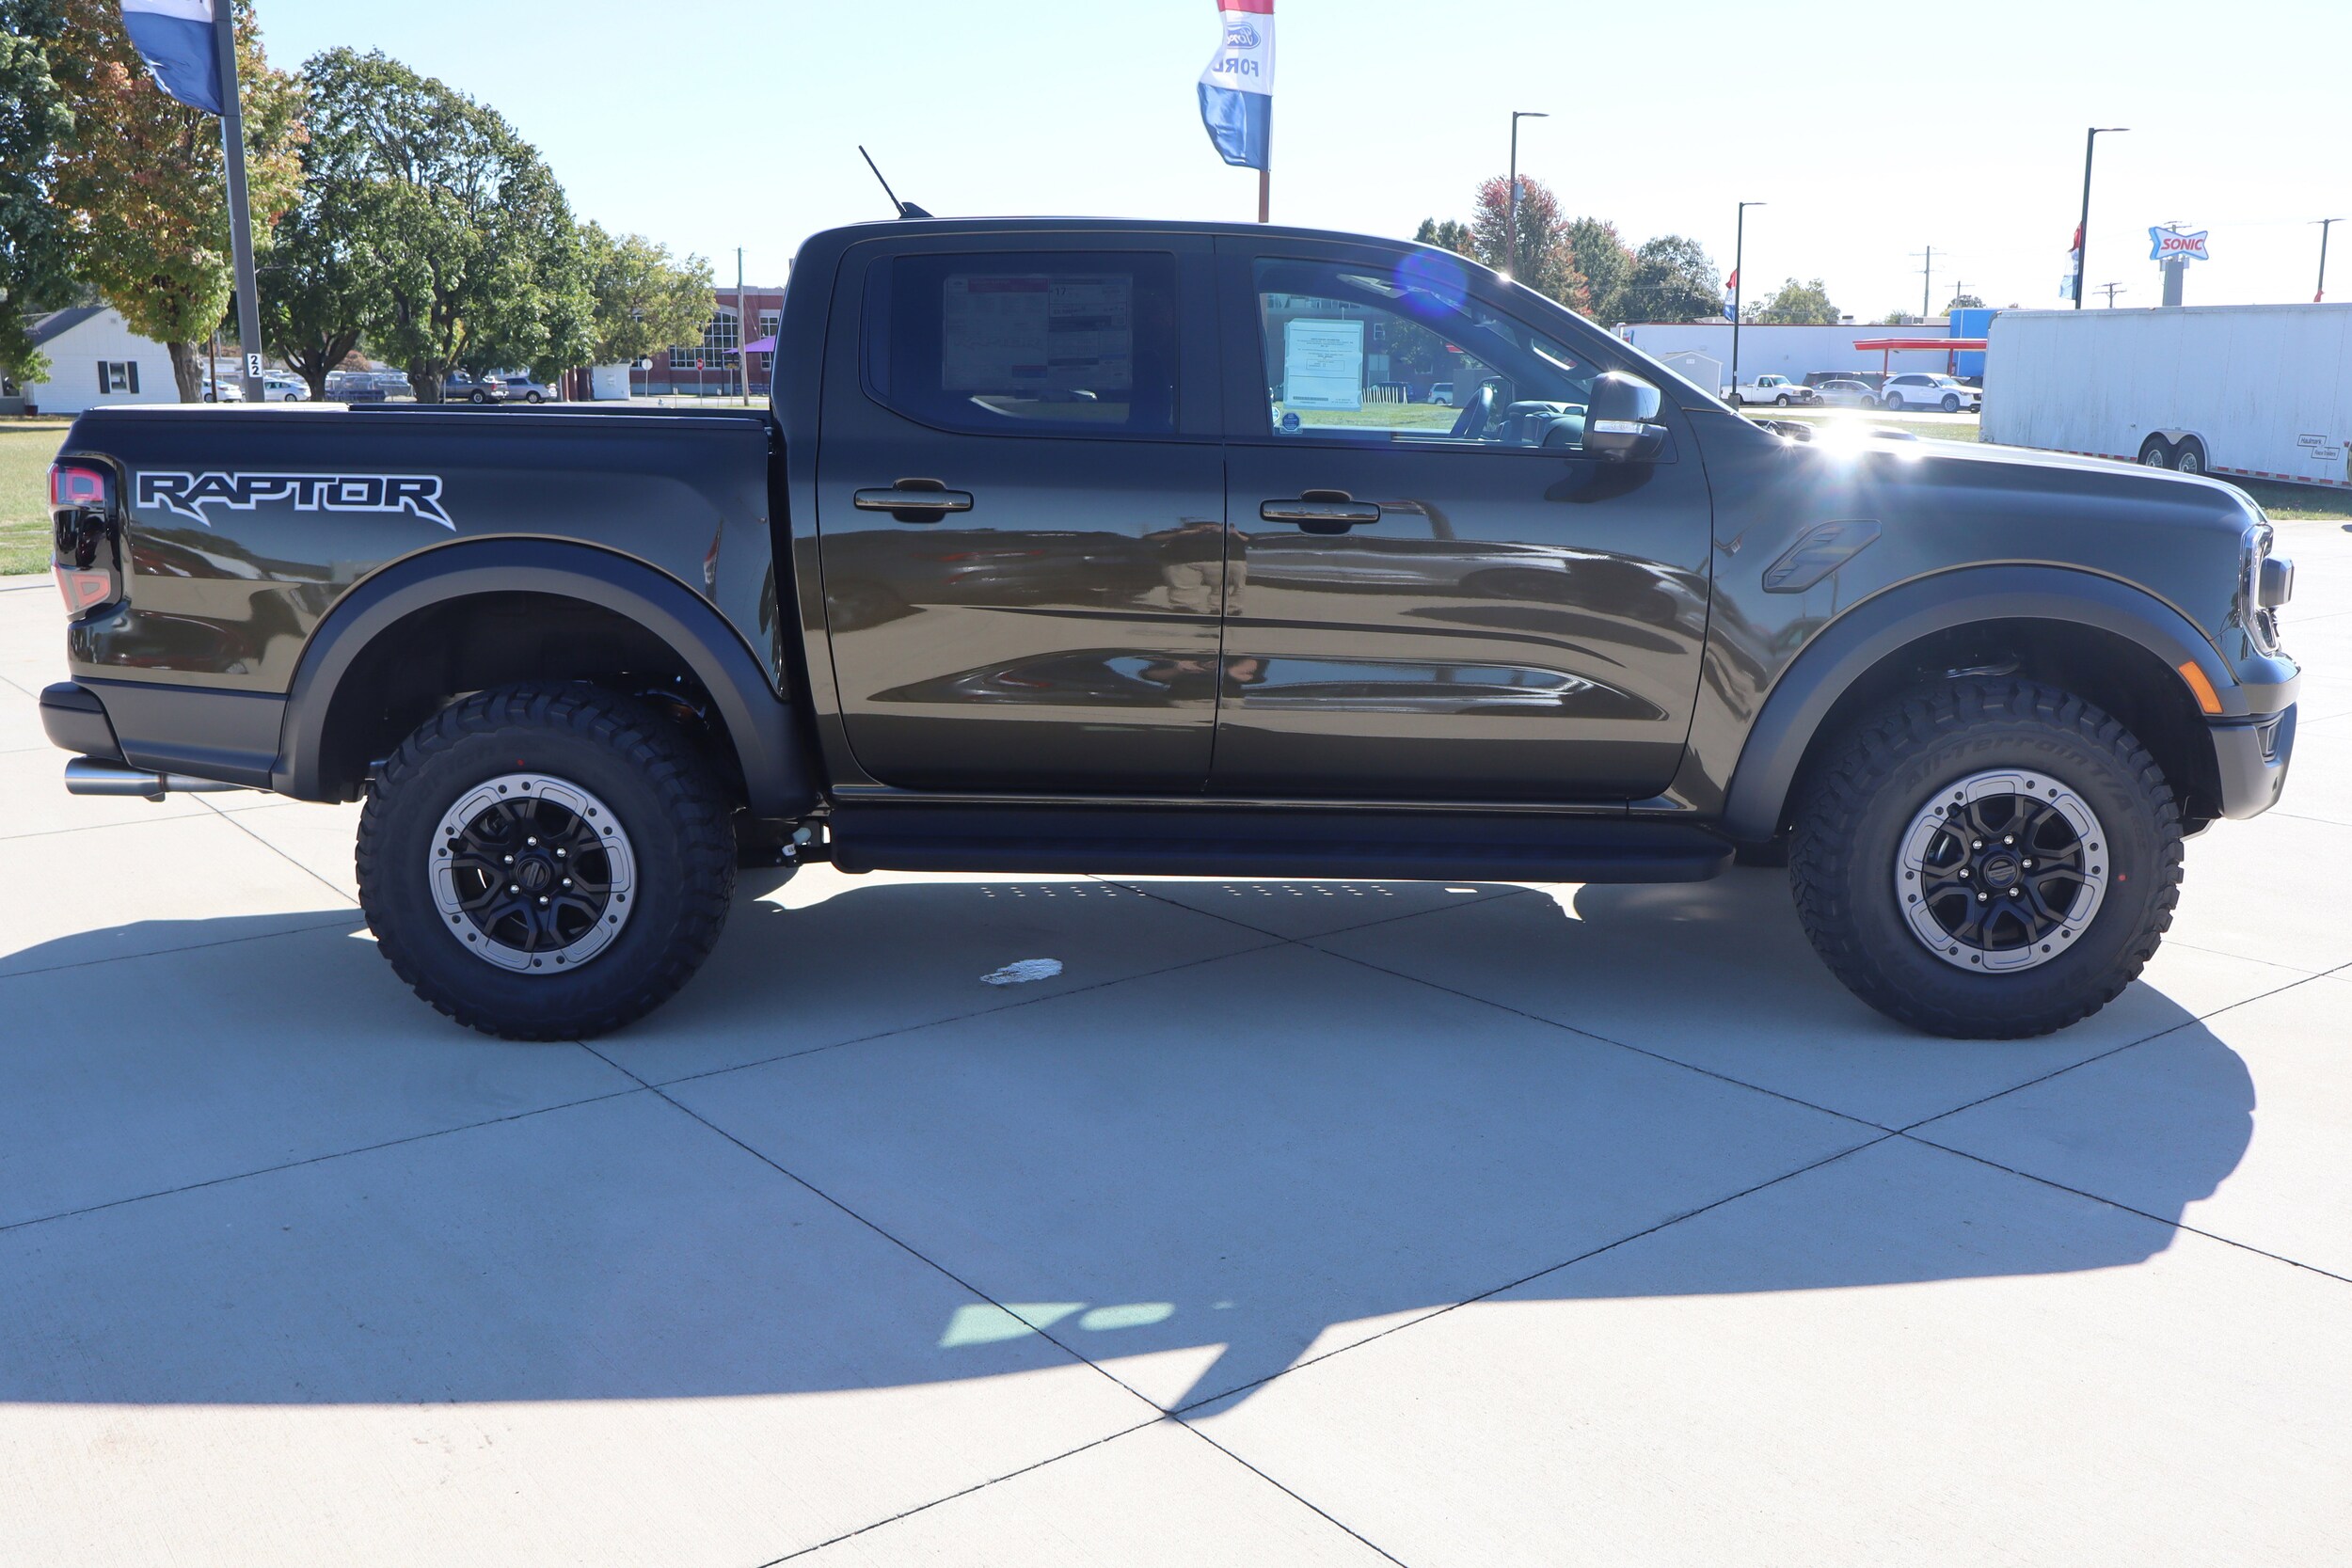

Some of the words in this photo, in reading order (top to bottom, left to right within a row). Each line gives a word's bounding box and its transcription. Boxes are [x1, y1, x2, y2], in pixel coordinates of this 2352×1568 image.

[2161, 238, 2204, 250] SONIC
[2300, 436, 2322, 445] Haulmark
[136, 471, 456, 532] RAPTOR
[1904, 735, 2090, 796] All-Terrain
